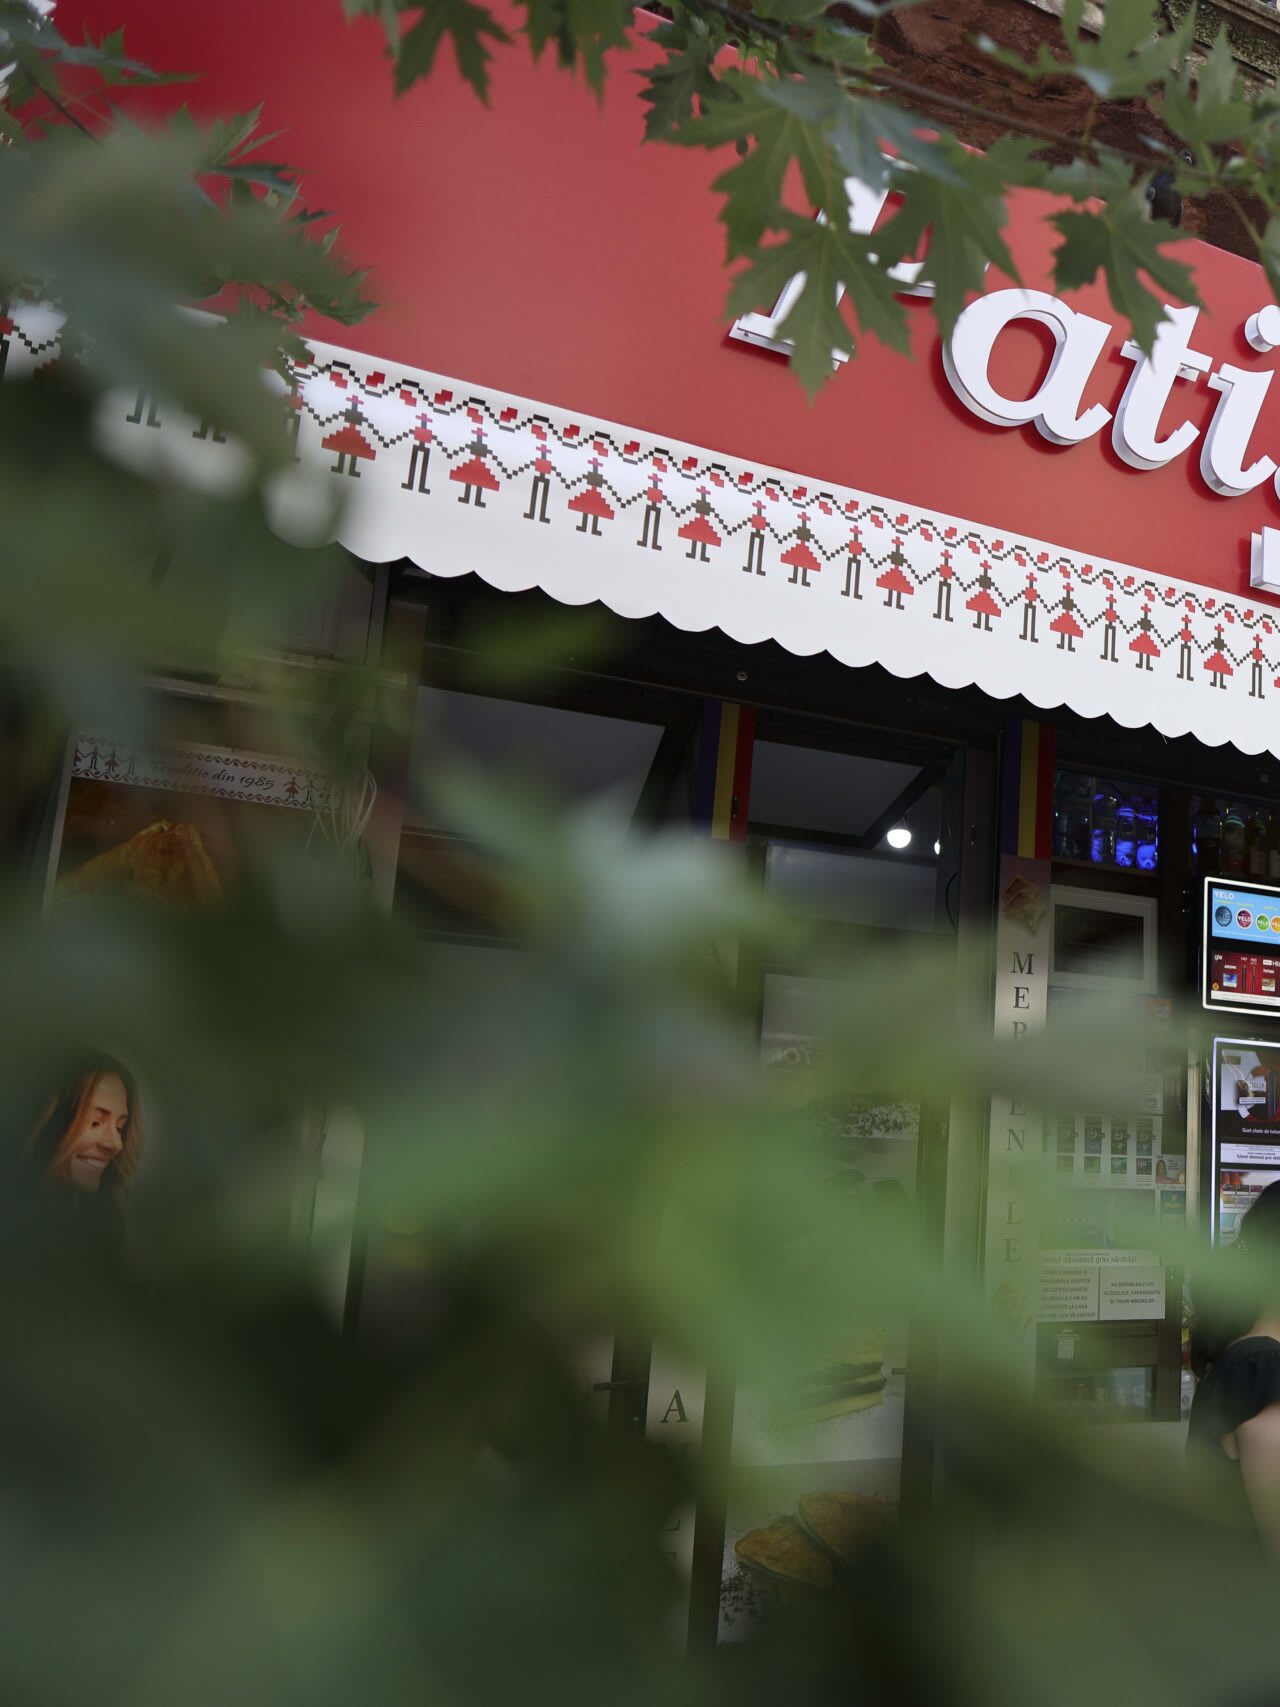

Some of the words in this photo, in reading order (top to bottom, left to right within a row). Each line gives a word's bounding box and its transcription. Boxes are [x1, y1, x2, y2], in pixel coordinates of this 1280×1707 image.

[212, 768, 235, 783] din
[239, 775, 275, 791] 1985
[1214, 890, 1235, 900] VELO
